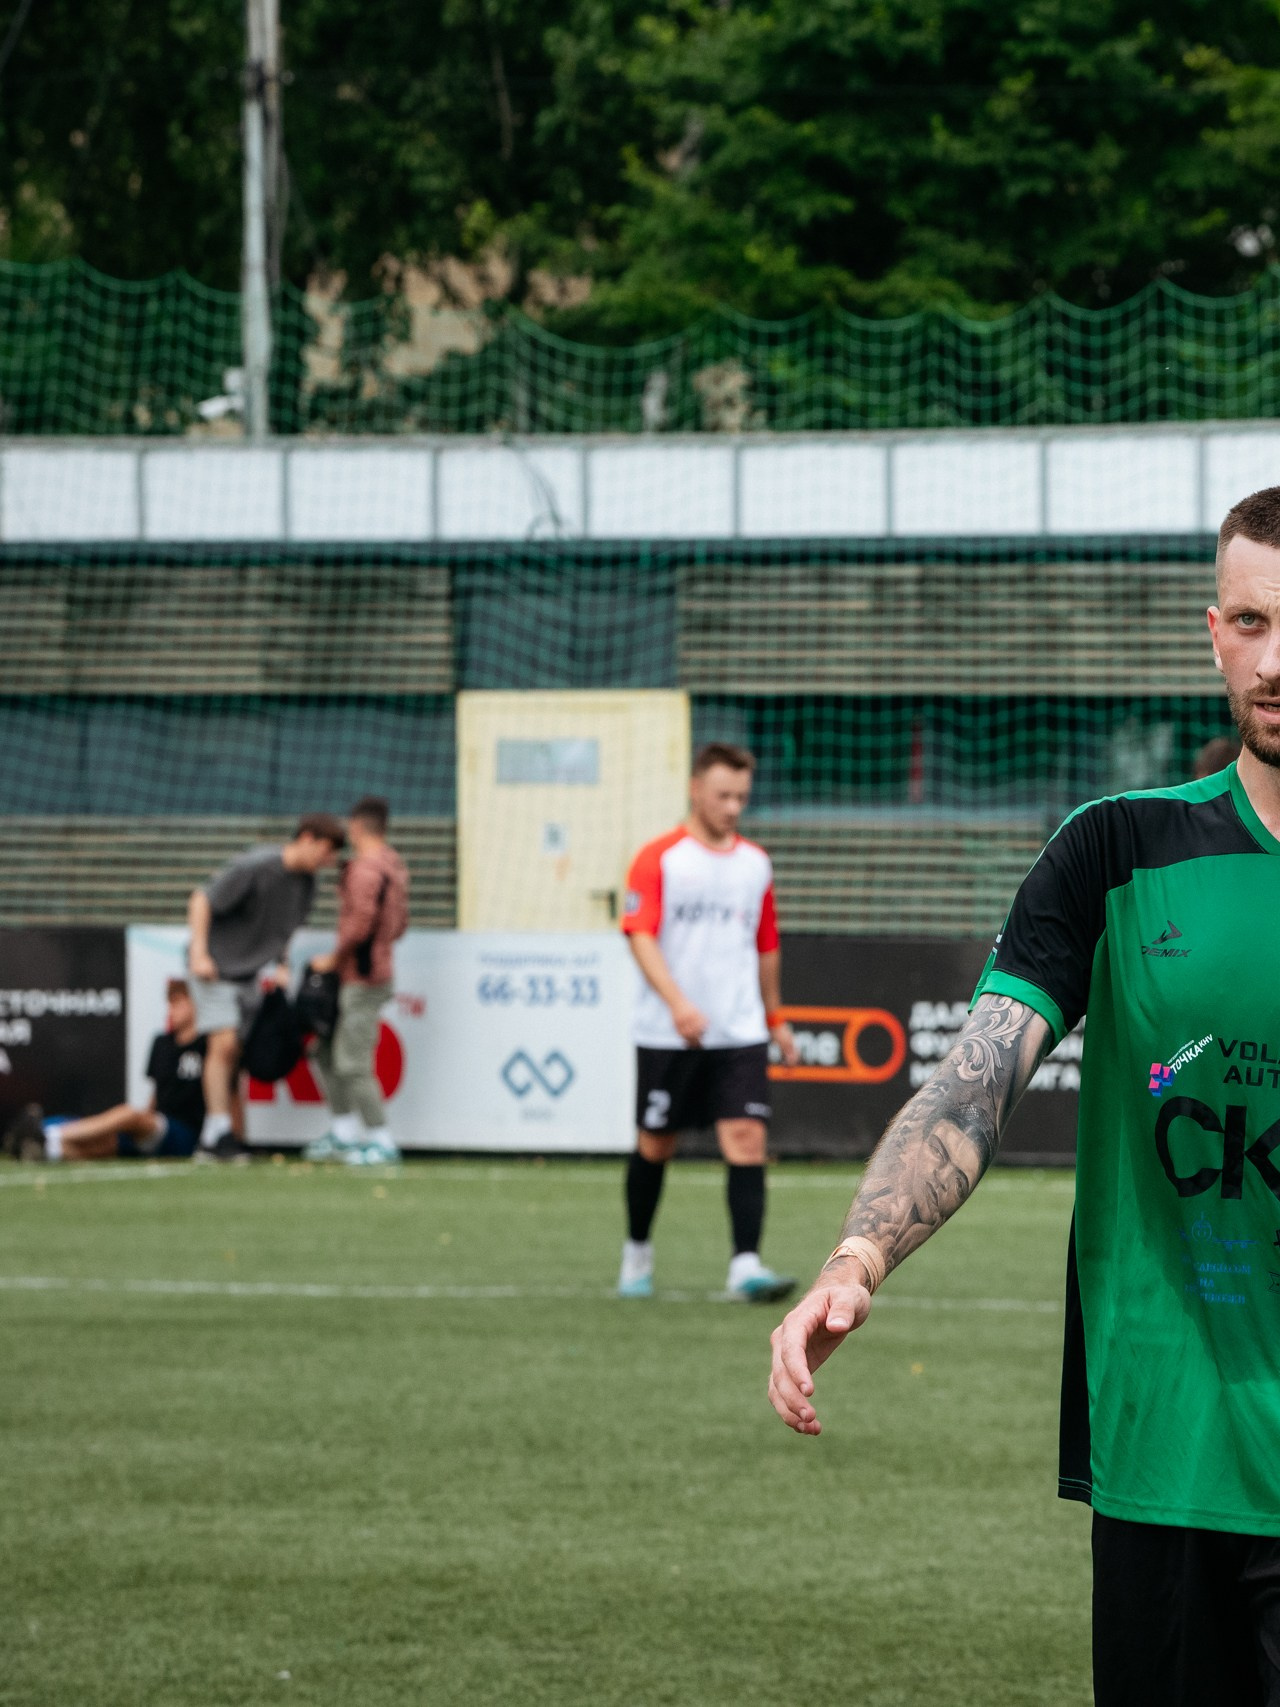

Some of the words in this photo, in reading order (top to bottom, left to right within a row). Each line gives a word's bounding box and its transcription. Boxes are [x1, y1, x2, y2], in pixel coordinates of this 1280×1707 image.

[1141, 945, 1193, 958] DEMIX
[1170, 1044, 1203, 1075] ТОЧКА
[1198, 1033, 1213, 1049] KHV
